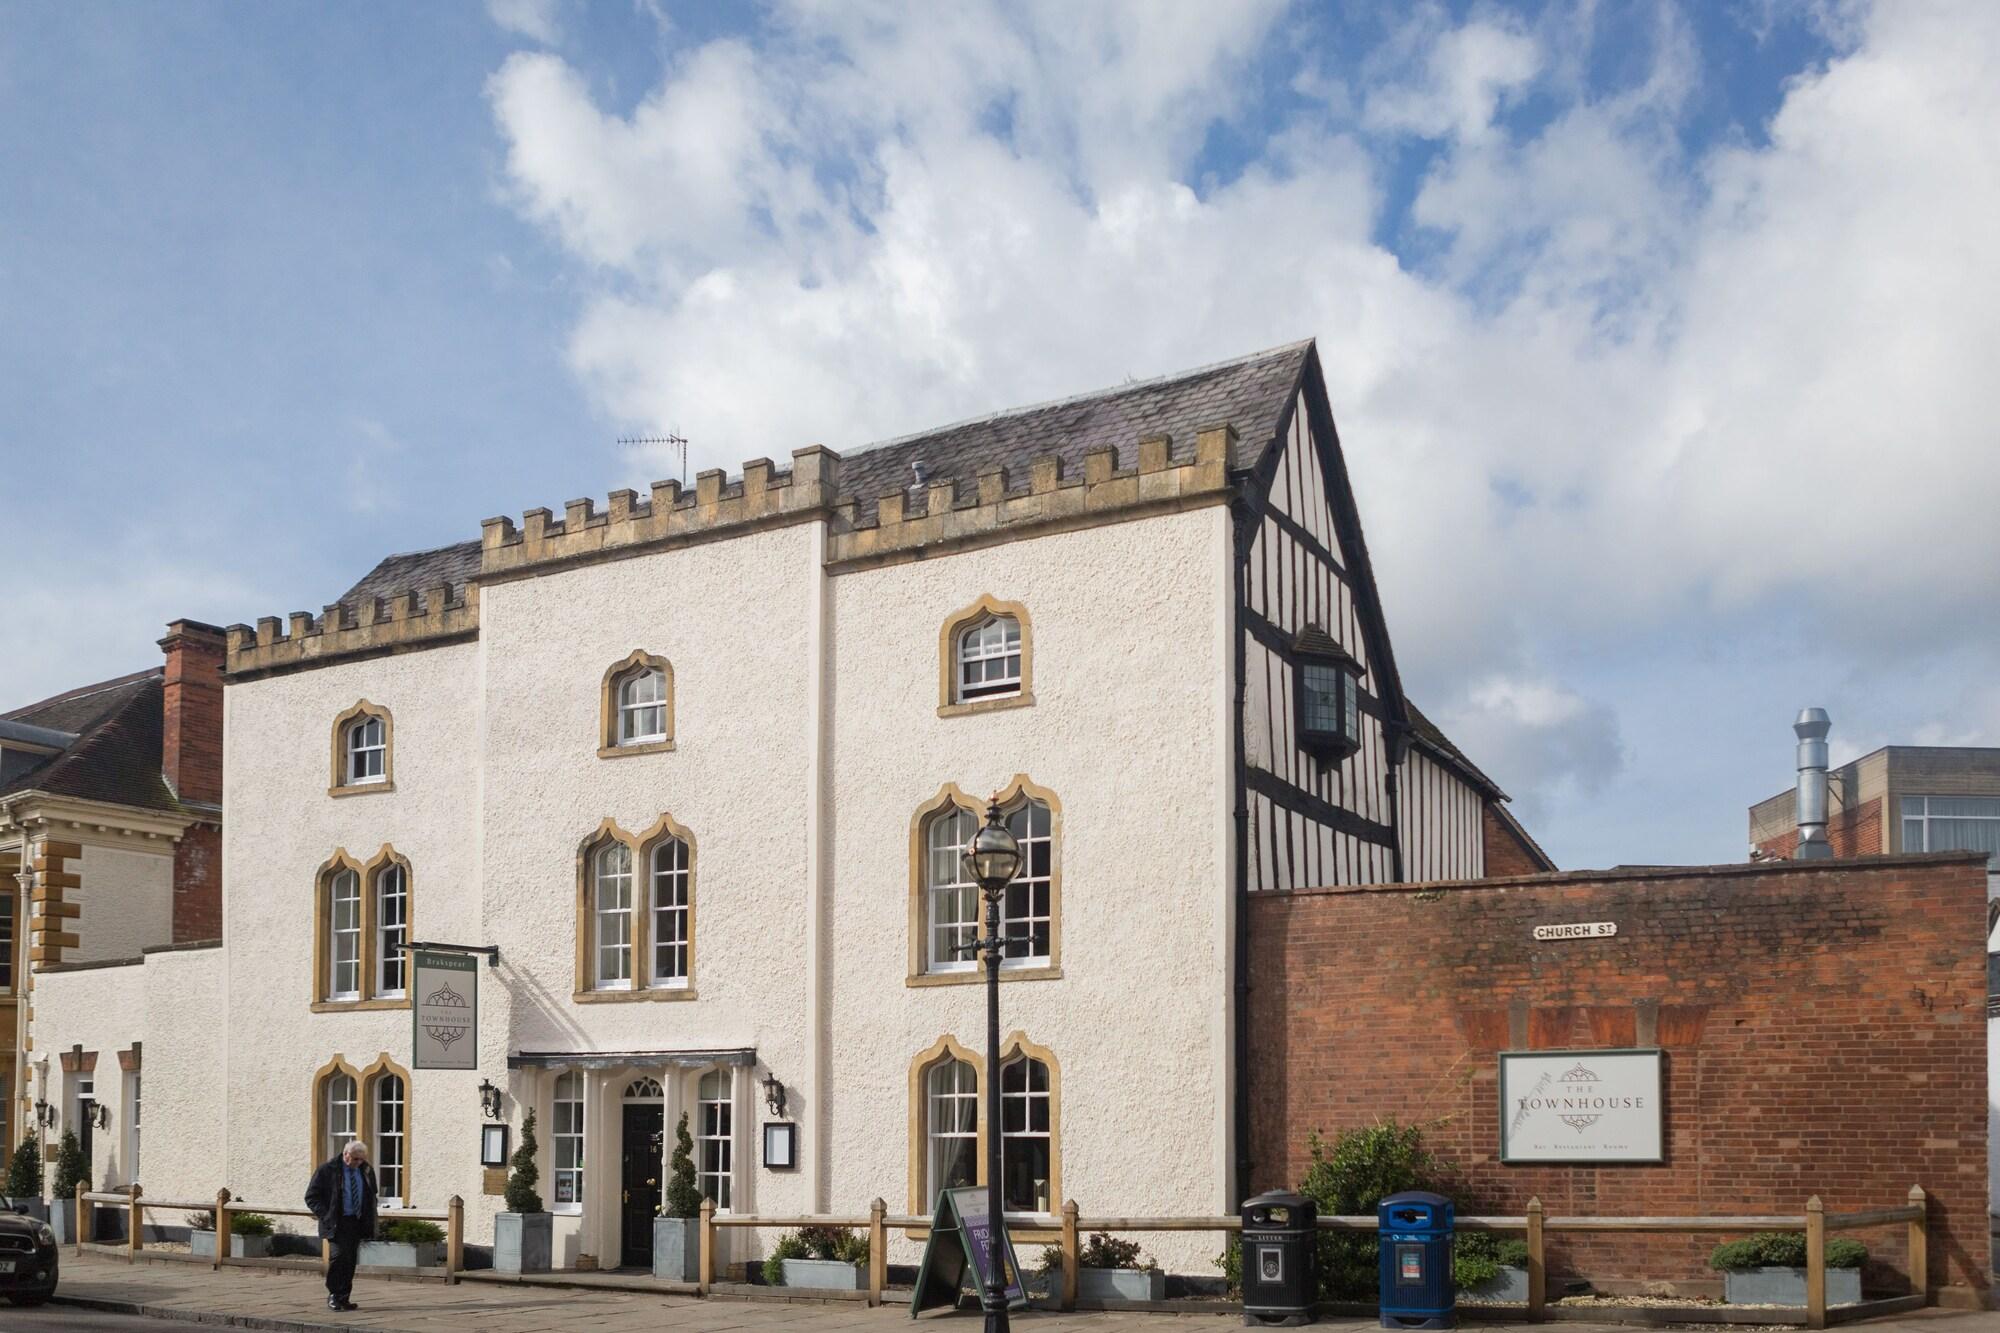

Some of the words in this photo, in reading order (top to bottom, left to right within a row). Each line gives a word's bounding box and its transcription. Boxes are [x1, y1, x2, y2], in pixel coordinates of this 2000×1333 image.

[1537, 925, 1591, 937] CHURCH
[426, 958, 465, 968] Brakspear
[421, 1015, 471, 1023] TOWNHOUSE
[1567, 1086, 1593, 1094] THE
[1518, 1097, 1644, 1110] TOWNHOUSE
[973, 1228, 990, 1241] FRID
